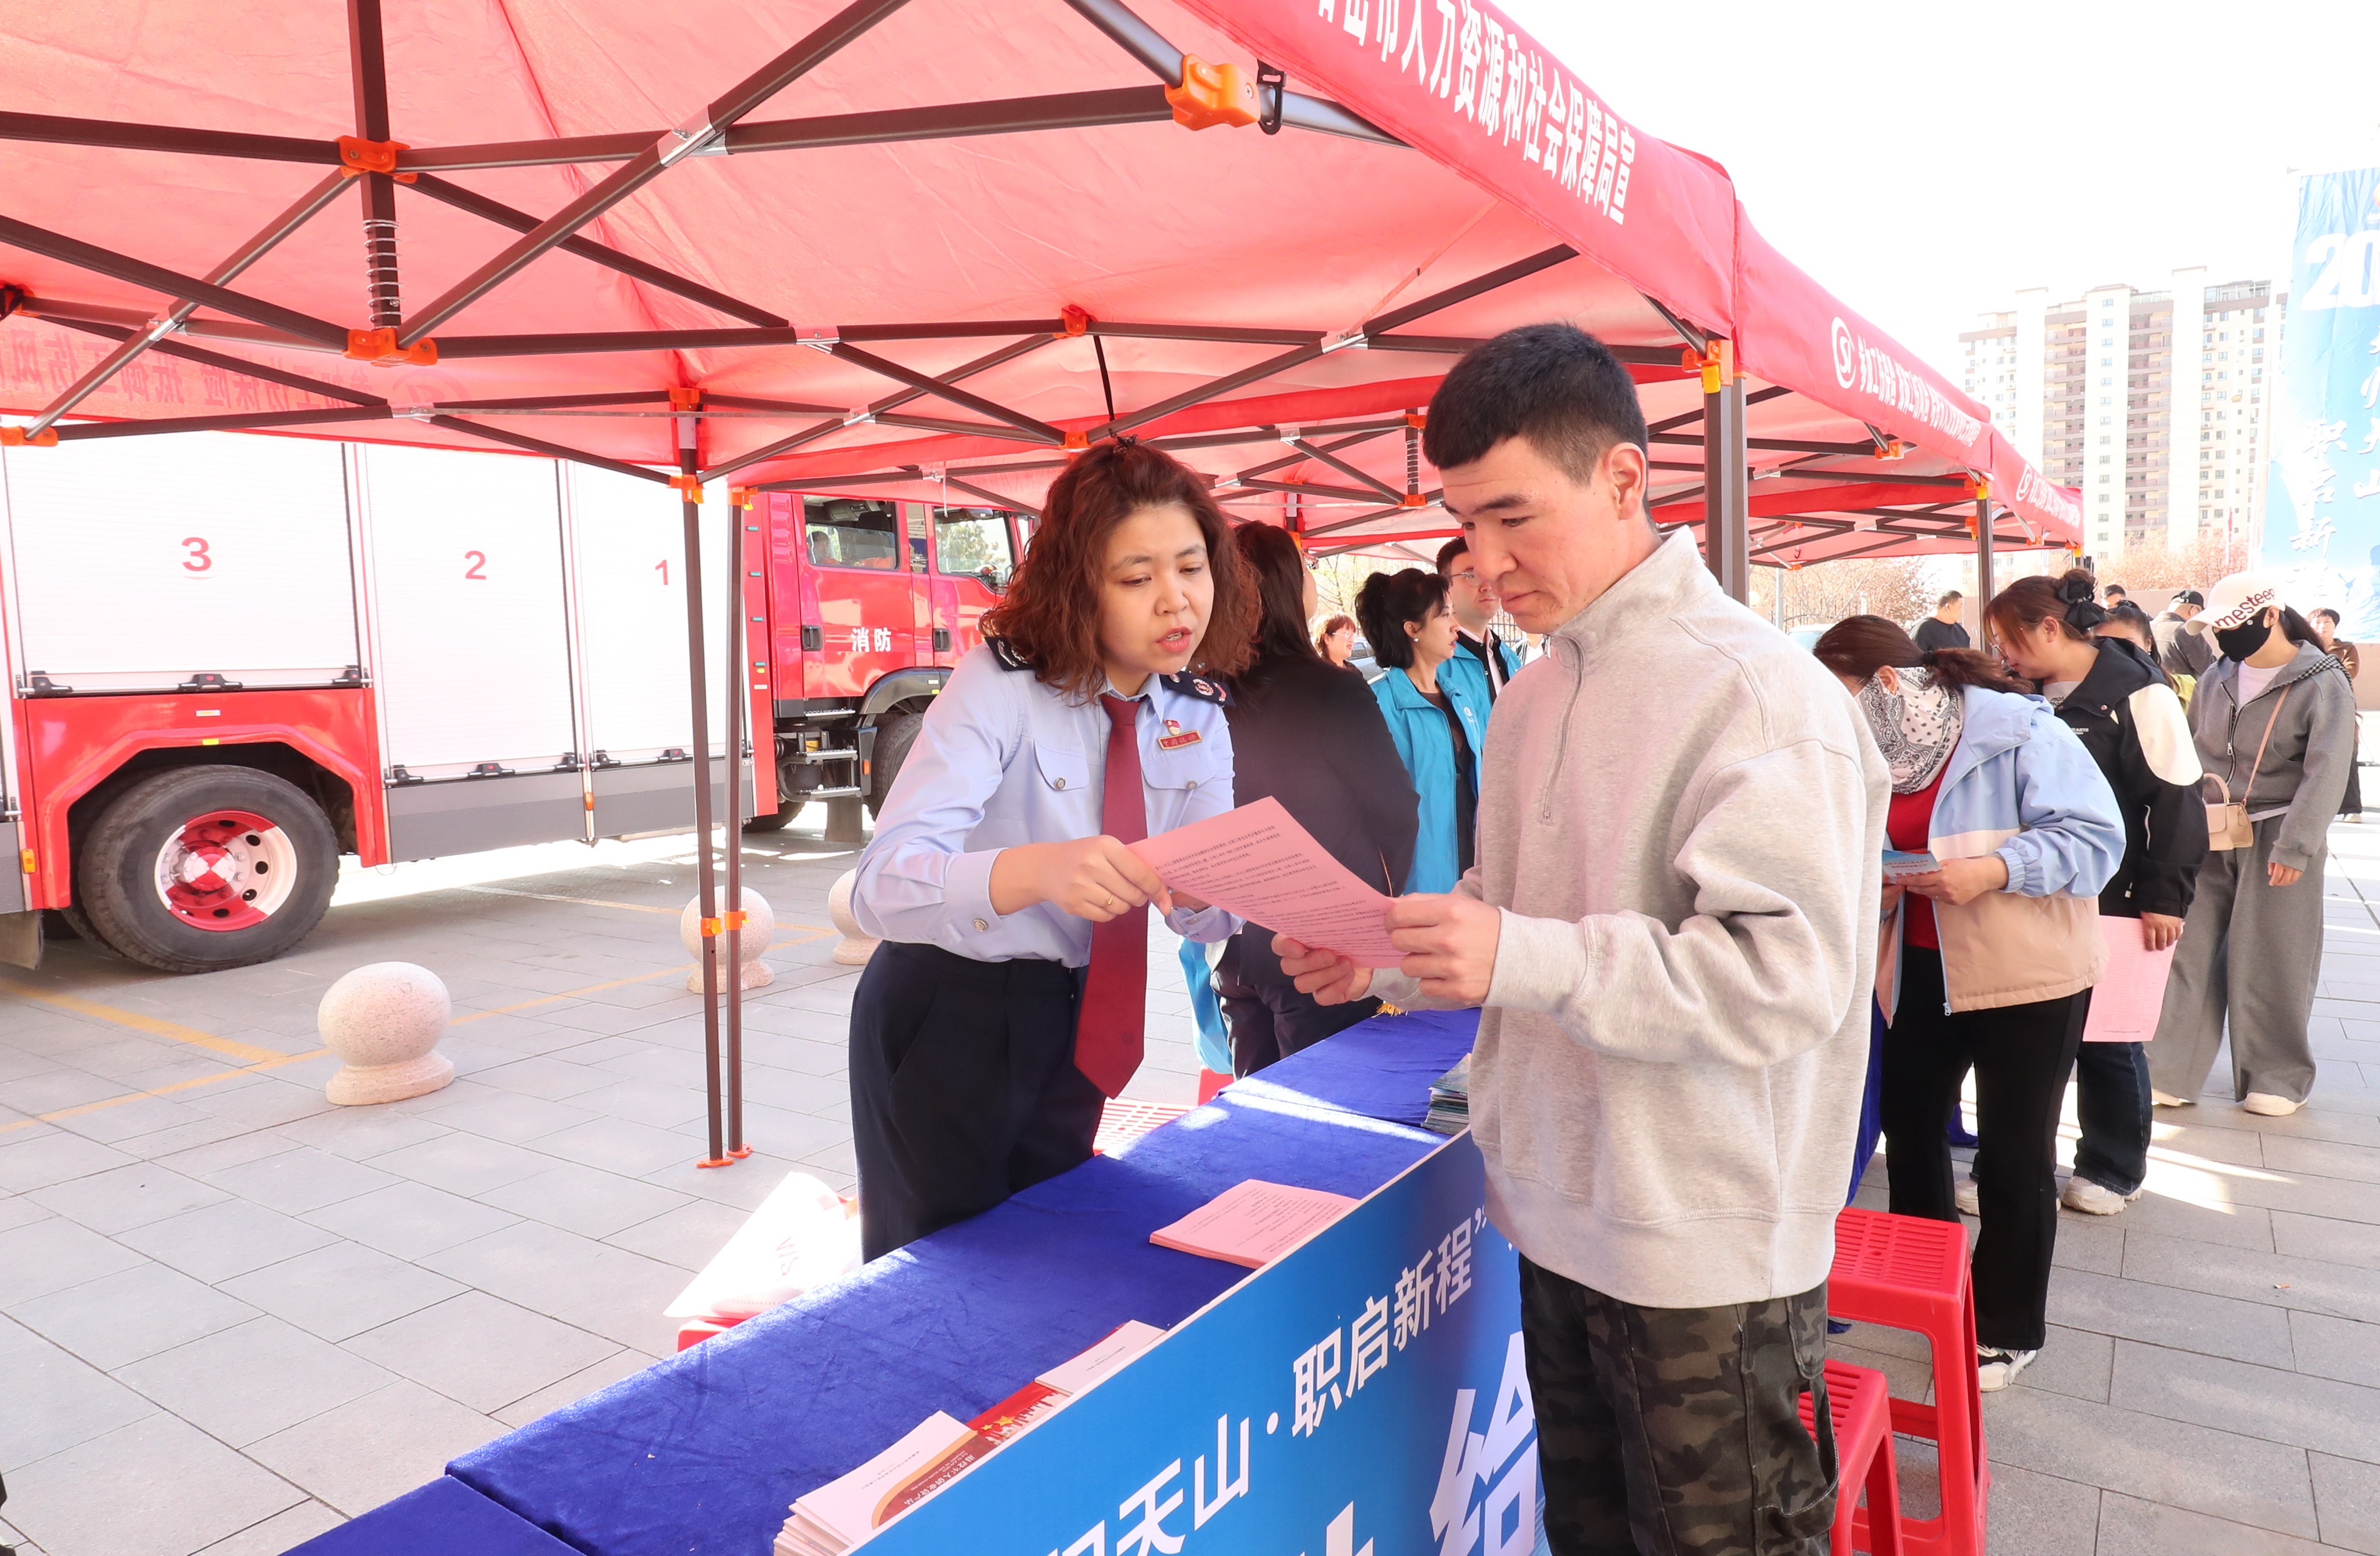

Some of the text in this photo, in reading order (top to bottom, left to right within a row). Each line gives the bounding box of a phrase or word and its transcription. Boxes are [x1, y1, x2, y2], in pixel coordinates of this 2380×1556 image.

[1318, 0, 1635, 225] 市人力资源和社会保障局宣
[2300, 231, 2380, 311] 20
[181, 537, 211, 571] 3
[464, 550, 486, 580] 2
[655, 559, 669, 585] 1
[852, 626, 892, 652] 消防
[1047, 1208, 1486, 1556] 天山·职启新程”
